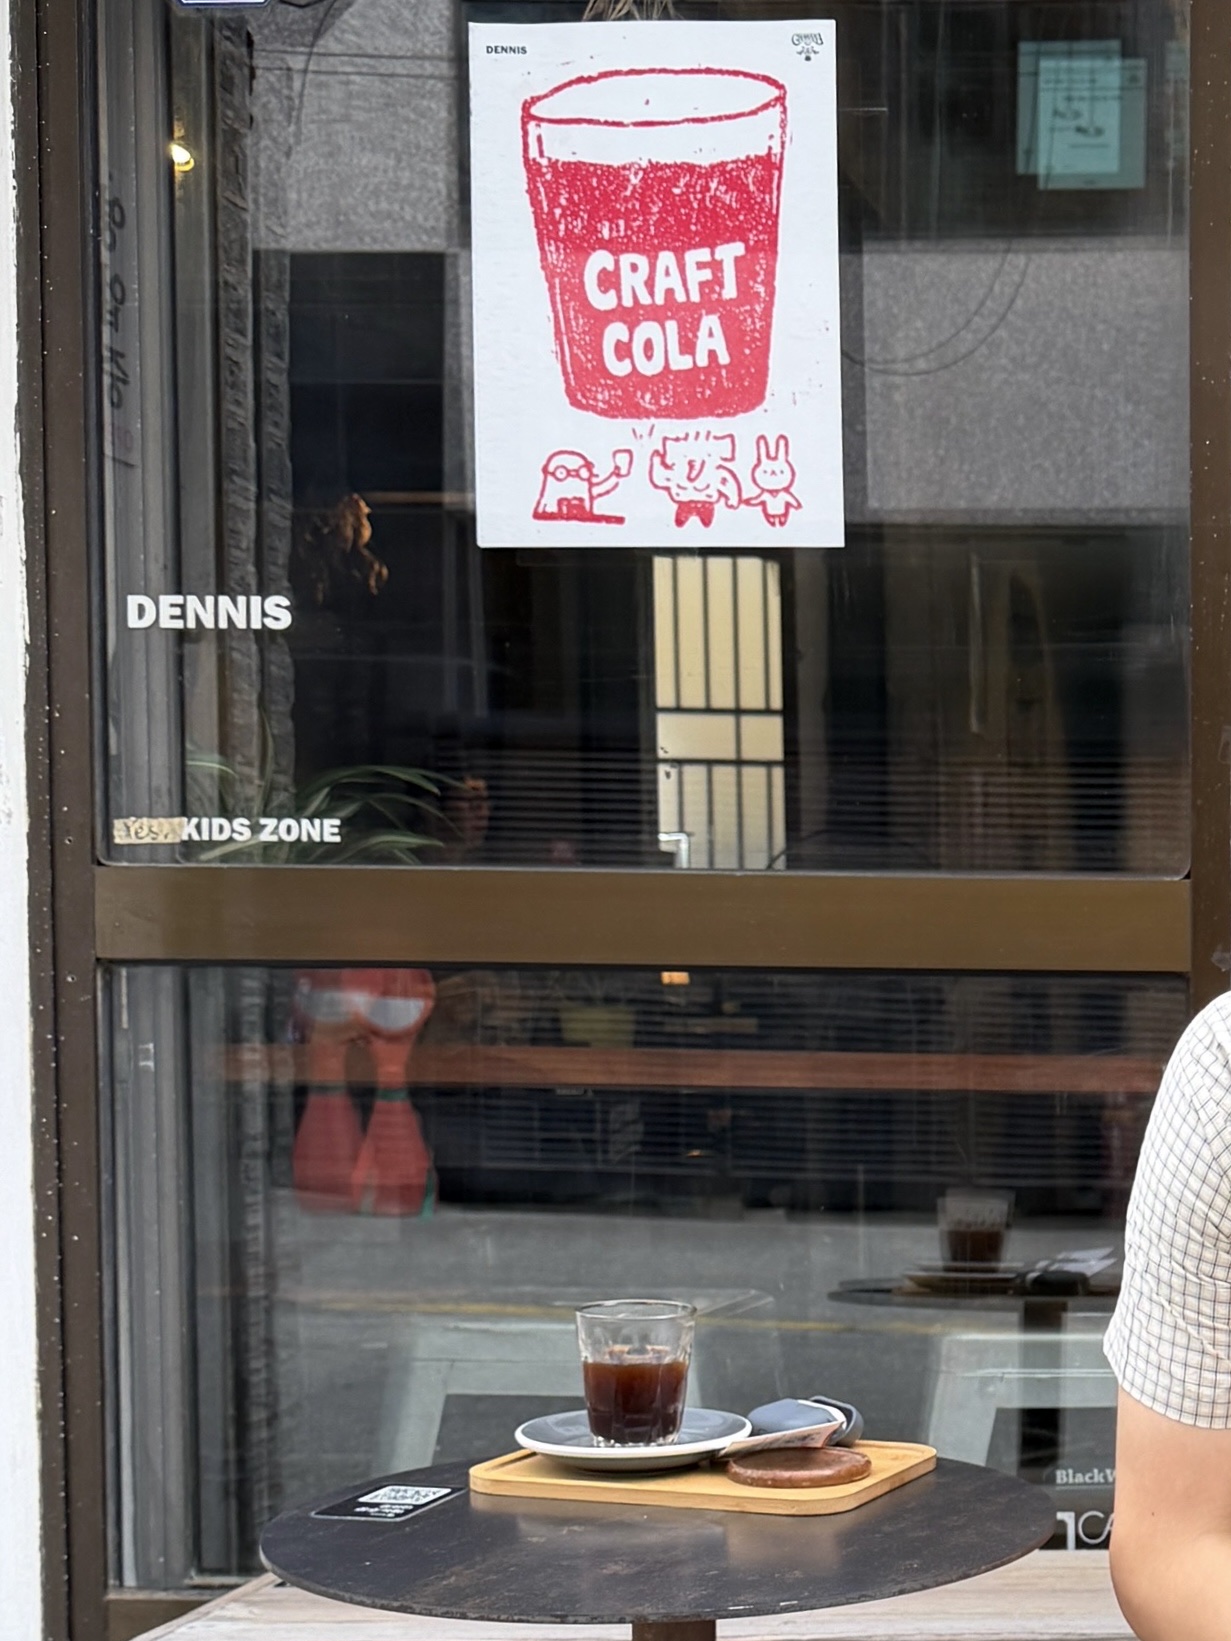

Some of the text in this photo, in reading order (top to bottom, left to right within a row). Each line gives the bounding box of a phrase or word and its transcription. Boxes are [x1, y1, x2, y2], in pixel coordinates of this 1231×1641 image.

[486, 45, 527, 55] DENNIS
[584, 241, 746, 311] CRAFT
[602, 314, 731, 377] COLA
[126, 594, 292, 630] DENNIS
[182, 816, 252, 841] KIDS
[258, 817, 342, 843] ZONE
